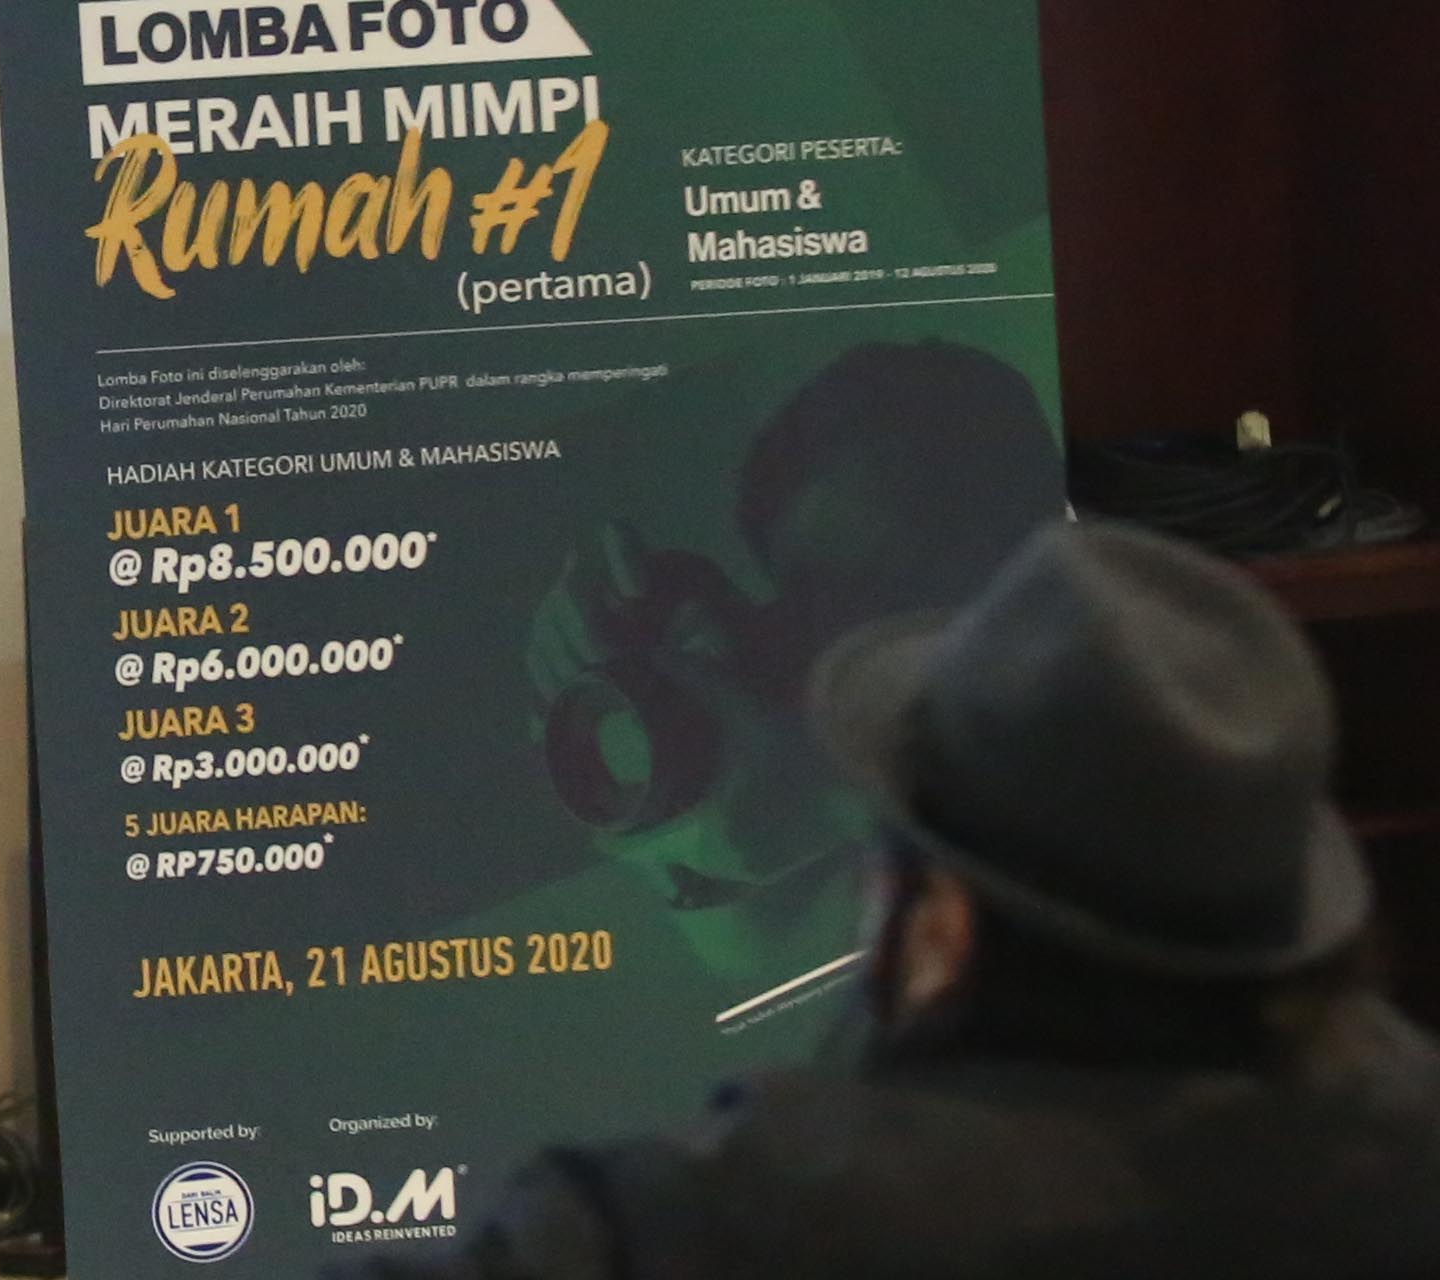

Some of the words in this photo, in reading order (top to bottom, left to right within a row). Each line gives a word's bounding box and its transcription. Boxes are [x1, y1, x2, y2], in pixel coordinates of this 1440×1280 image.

[99, 3, 337, 66] LOMBA
[86, 89, 362, 160] MERAIH
[383, 75, 601, 143] MIMPI
[680, 142, 797, 169] KATEGORI
[800, 136, 904, 162] PESERTA:
[84, 124, 454, 300] Rumah
[469, 120, 610, 264] #1
[684, 182, 792, 218] Umum
[796, 178, 823, 211] &
[687, 225, 870, 264] Mahasiswa
[456, 260, 653, 315] (pertama)
[96, 372, 148, 389] Lomba
[150, 369, 184, 385] Foto
[186, 366, 205, 382] ini
[207, 360, 327, 383] diselenggarakan
[98, 391, 172, 410] Direktorat
[174, 387, 238, 406] Jenderal
[240, 384, 321, 402] Perumahan
[324, 378, 416, 399] Kementerian
[419, 374, 459, 391] PUPR
[465, 372, 511, 388] dalam
[100, 417, 130, 434] Hari
[133, 413, 216, 432] Perumahan
[218, 408, 281, 427] Nasional
[283, 405, 327, 423] Tahun
[330, 402, 368, 420] 2020
[106, 458, 197, 486] HADIAH
[200, 453, 315, 481] KATEGORI
[319, 448, 394, 475] UMUM
[398, 446, 416, 470] &
[420, 438, 562, 467] MAHASISWA
[105, 506, 218, 542] JUARA
[226, 503, 242, 534] 1
[108, 548, 144, 588] @
[111, 605, 224, 642] JUARA
[229, 602, 250, 634] 2
[114, 652, 146, 687] @
[117, 705, 229, 742] JUARA
[235, 701, 256, 734] 3
[120, 754, 146, 784] @
[124, 813, 140, 838] 5
[146, 807, 232, 837] JUARA
[234, 800, 368, 832] HARAPAN:
[125, 852, 151, 881] @
[132, 950, 295, 999] JAKARTA,
[306, 945, 348, 988] 21
[360, 935, 515, 985] AGUSTUS
[525, 929, 614, 974] 2020
[147, 1125, 235, 1147] Supported
[237, 1122, 262, 1143] by:
[328, 1113, 413, 1136] Organized
[414, 1111, 439, 1132] by:
[167, 1197, 239, 1230] LENSA
[330, 1229, 372, 1244] IDEAS
[373, 1224, 457, 1242] REINVENTED
